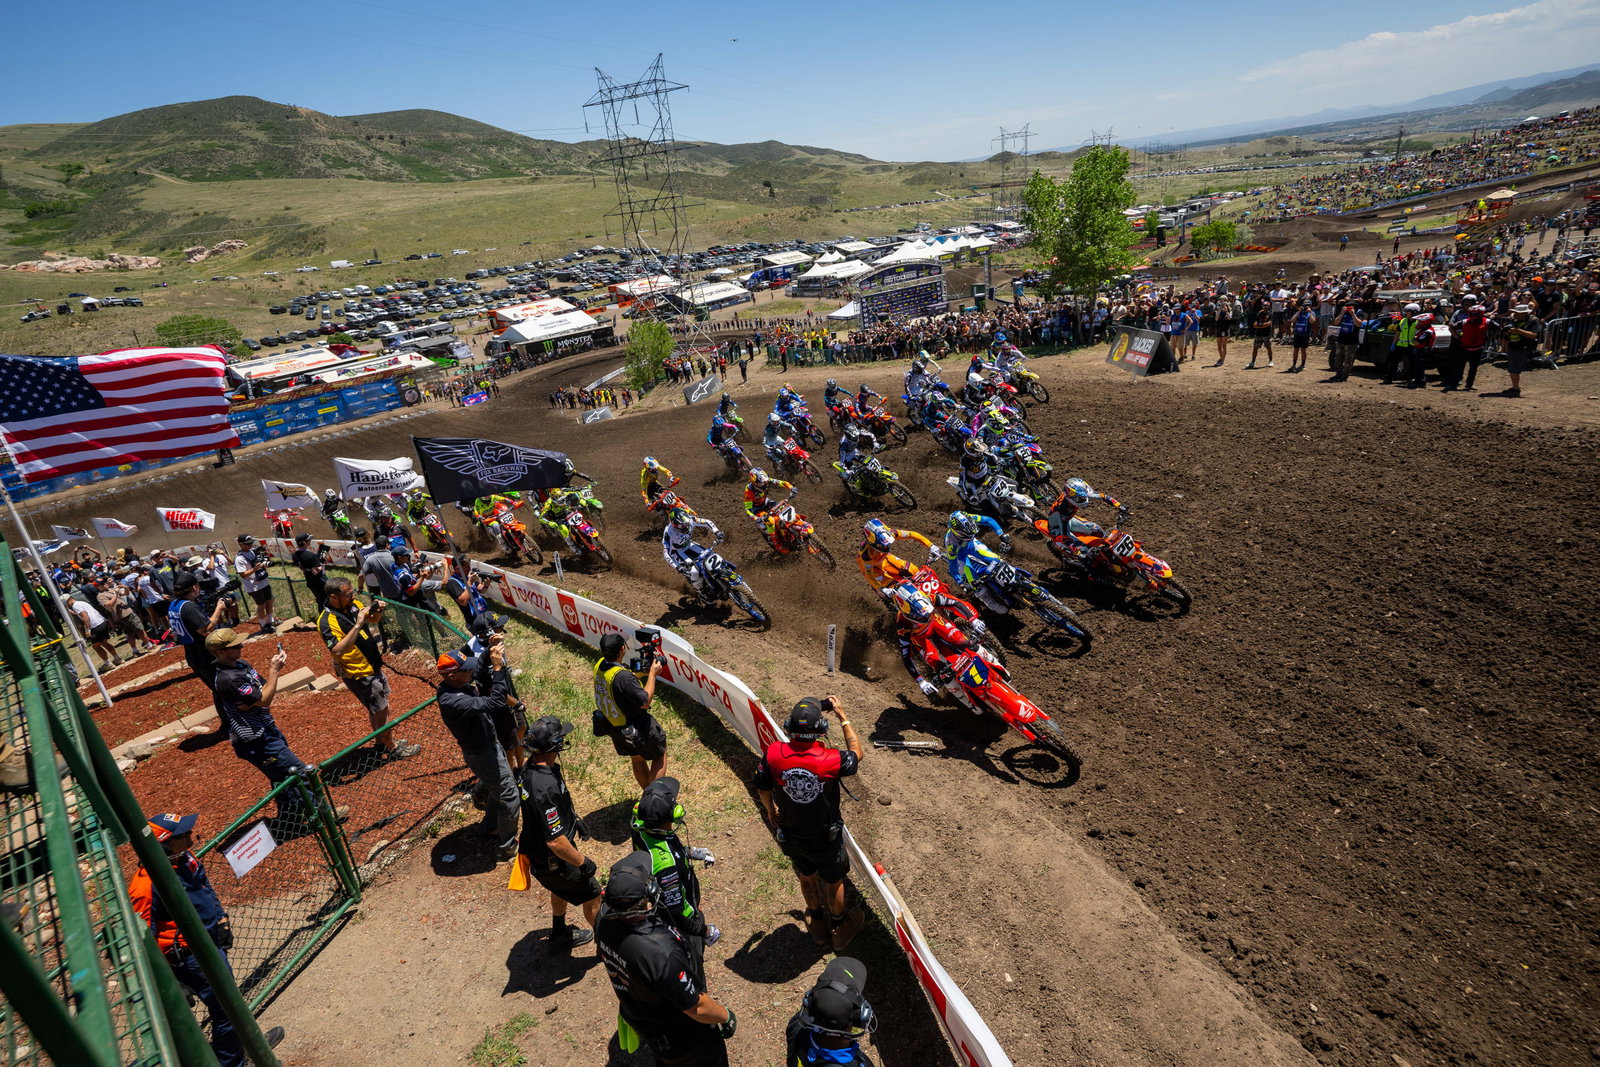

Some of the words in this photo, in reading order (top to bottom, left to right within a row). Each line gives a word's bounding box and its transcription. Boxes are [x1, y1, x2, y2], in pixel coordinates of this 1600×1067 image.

[557, 335, 593, 348] MONSTER
[479, 469, 492, 478] FOX
[493, 465, 524, 474] RACEWAY
[358, 484, 394, 492] Motocross
[994, 480, 1007, 497] 24
[166, 510, 198, 523] High
[571, 515, 583, 525] 14
[781, 506, 793, 522] 7
[1116, 535, 1134, 556] 26
[708, 553, 722, 571] 2
[997, 564, 1015, 584] 38
[922, 577, 940, 594] 96
[511, 585, 553, 614] TOYOTA
[969, 664, 984, 685] 1
[668, 653, 736, 717] TOYOTA
[237, 837, 262, 860] personnel
[247, 849, 258, 859] only
